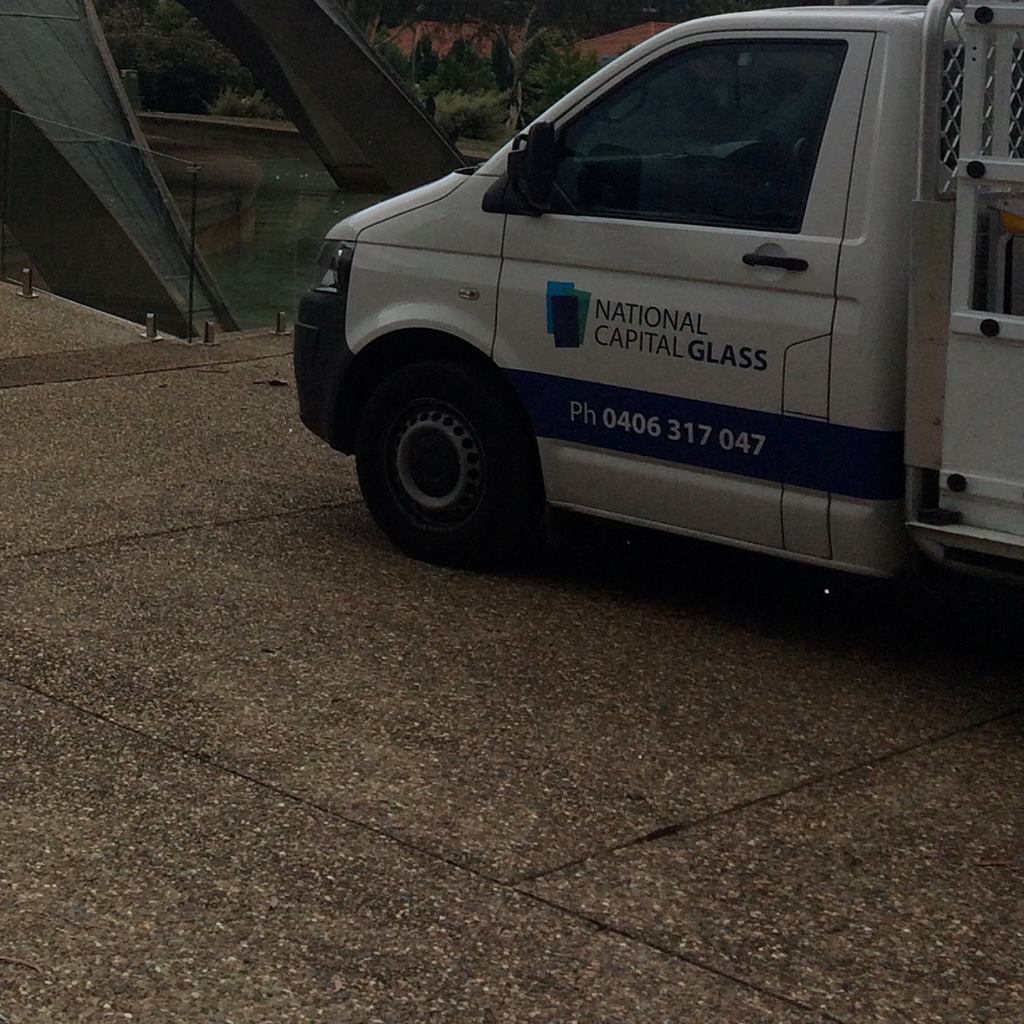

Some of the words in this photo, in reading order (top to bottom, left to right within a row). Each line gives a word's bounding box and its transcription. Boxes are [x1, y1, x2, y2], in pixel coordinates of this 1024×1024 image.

[595, 299, 708, 336] NATIONAL
[594, 325, 684, 358] CAPITAL
[687, 339, 769, 371] GLASS
[569, 401, 596, 426] Ph
[602, 408, 662, 437] 0406
[667, 418, 712, 446] 317
[719, 427, 767, 456] 047
